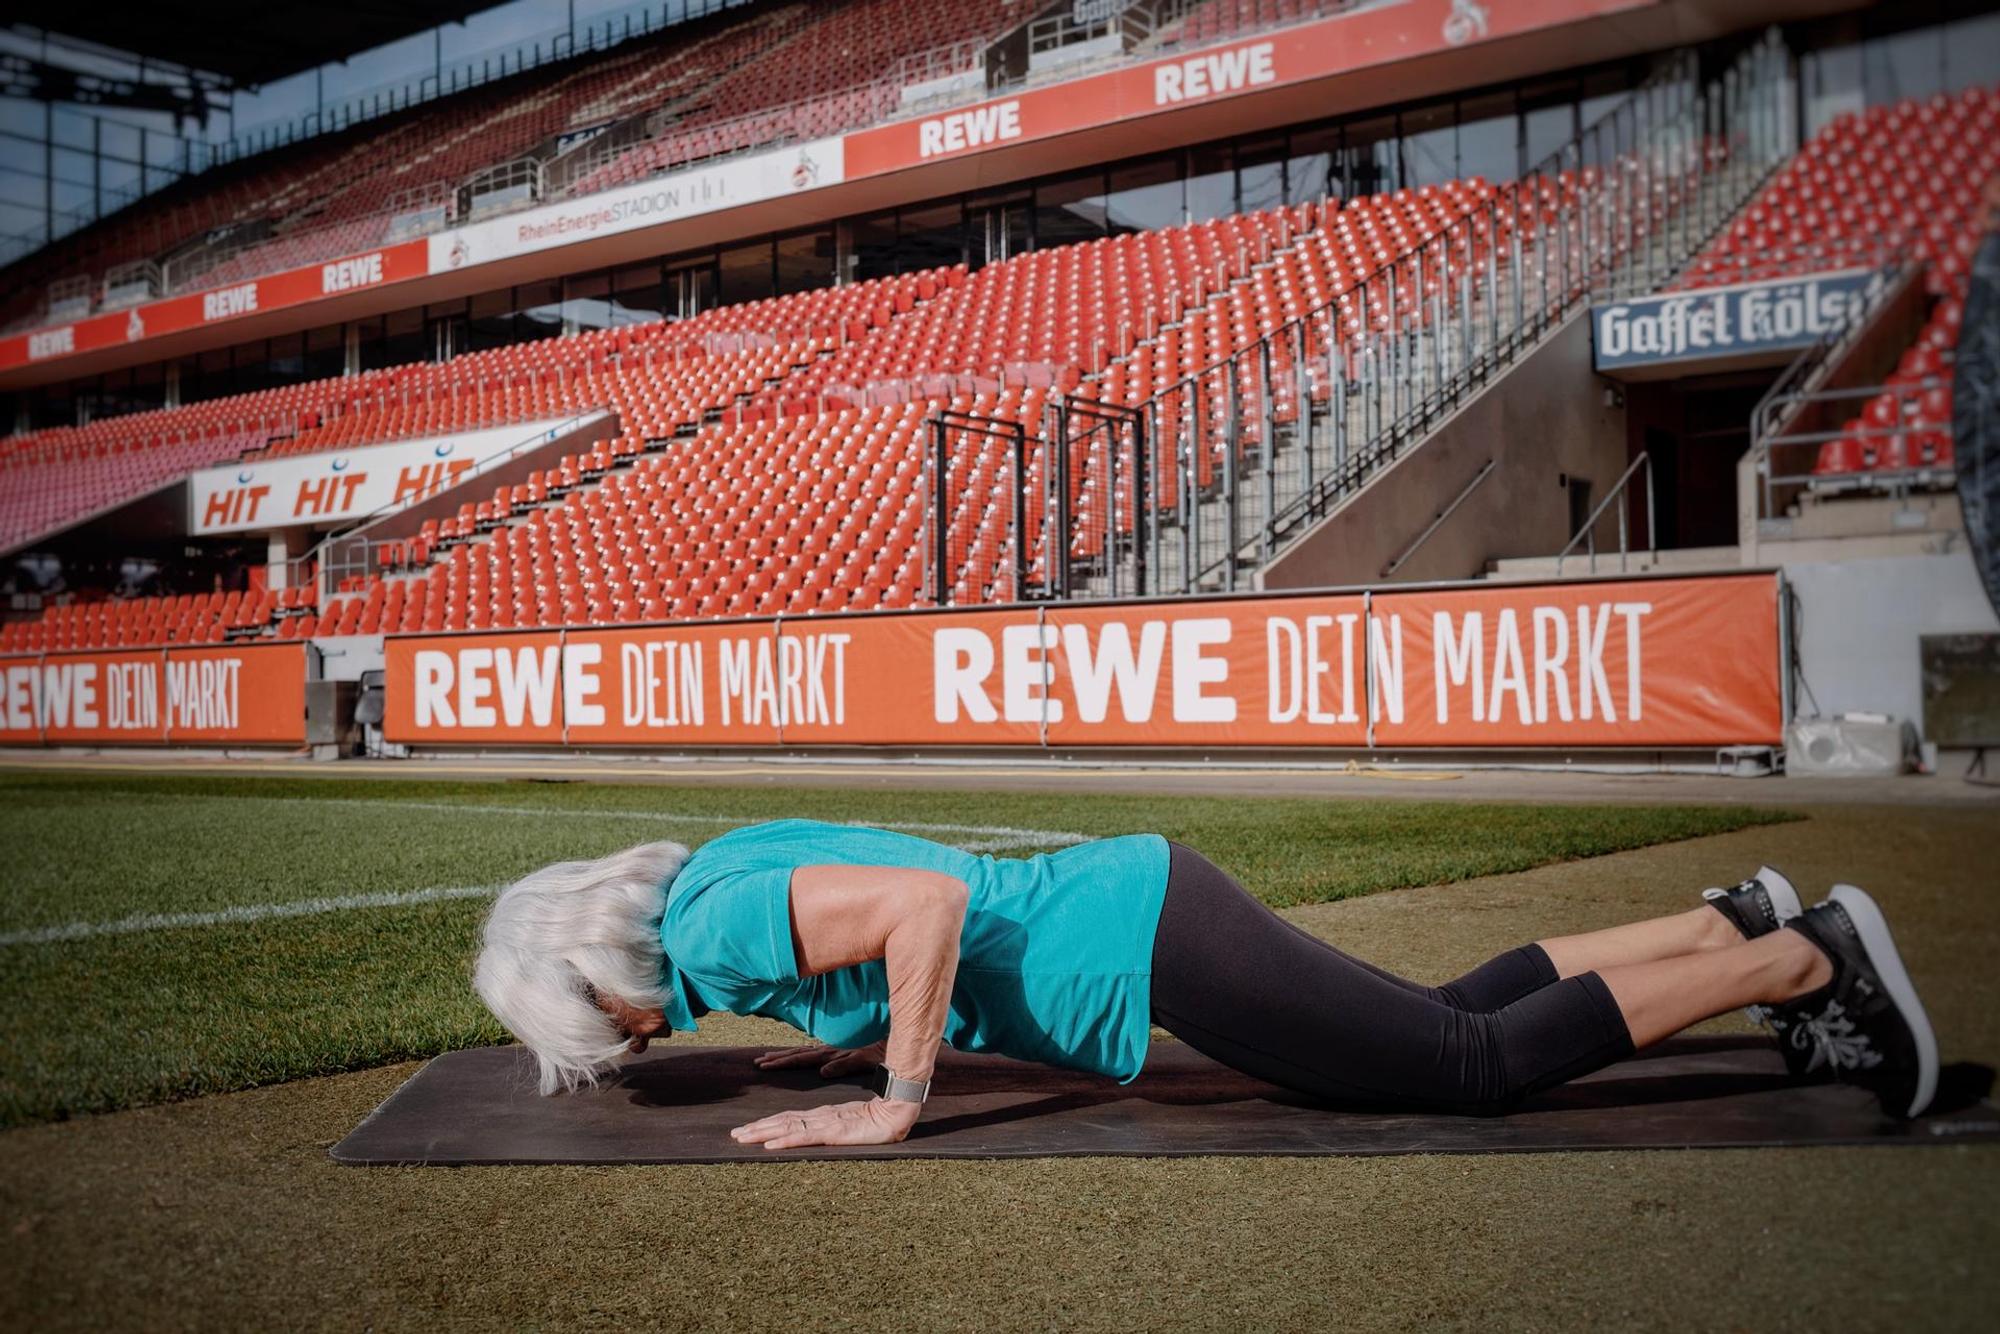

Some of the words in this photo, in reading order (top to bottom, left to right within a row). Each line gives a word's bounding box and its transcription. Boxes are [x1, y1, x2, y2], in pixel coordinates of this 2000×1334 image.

[1154, 43, 1276, 105] REWE
[919, 101, 1022, 158] REWE
[204, 283, 258, 321] REWE
[322, 253, 383, 294] REWE
[28, 326, 75, 360] REWE
[1600, 293, 1735, 357] Gaffel
[0, 663, 99, 729] EWE
[106, 661, 158, 729] DEIN
[165, 658, 242, 729] MARKT
[414, 643, 606, 728] REWE
[621, 640, 705, 728] DEIN
[719, 633, 851, 727] MARKT
[933, 617, 1238, 724] REWE
[1266, 613, 1404, 725] DEIN
[1433, 602, 1652, 726] MARKT
